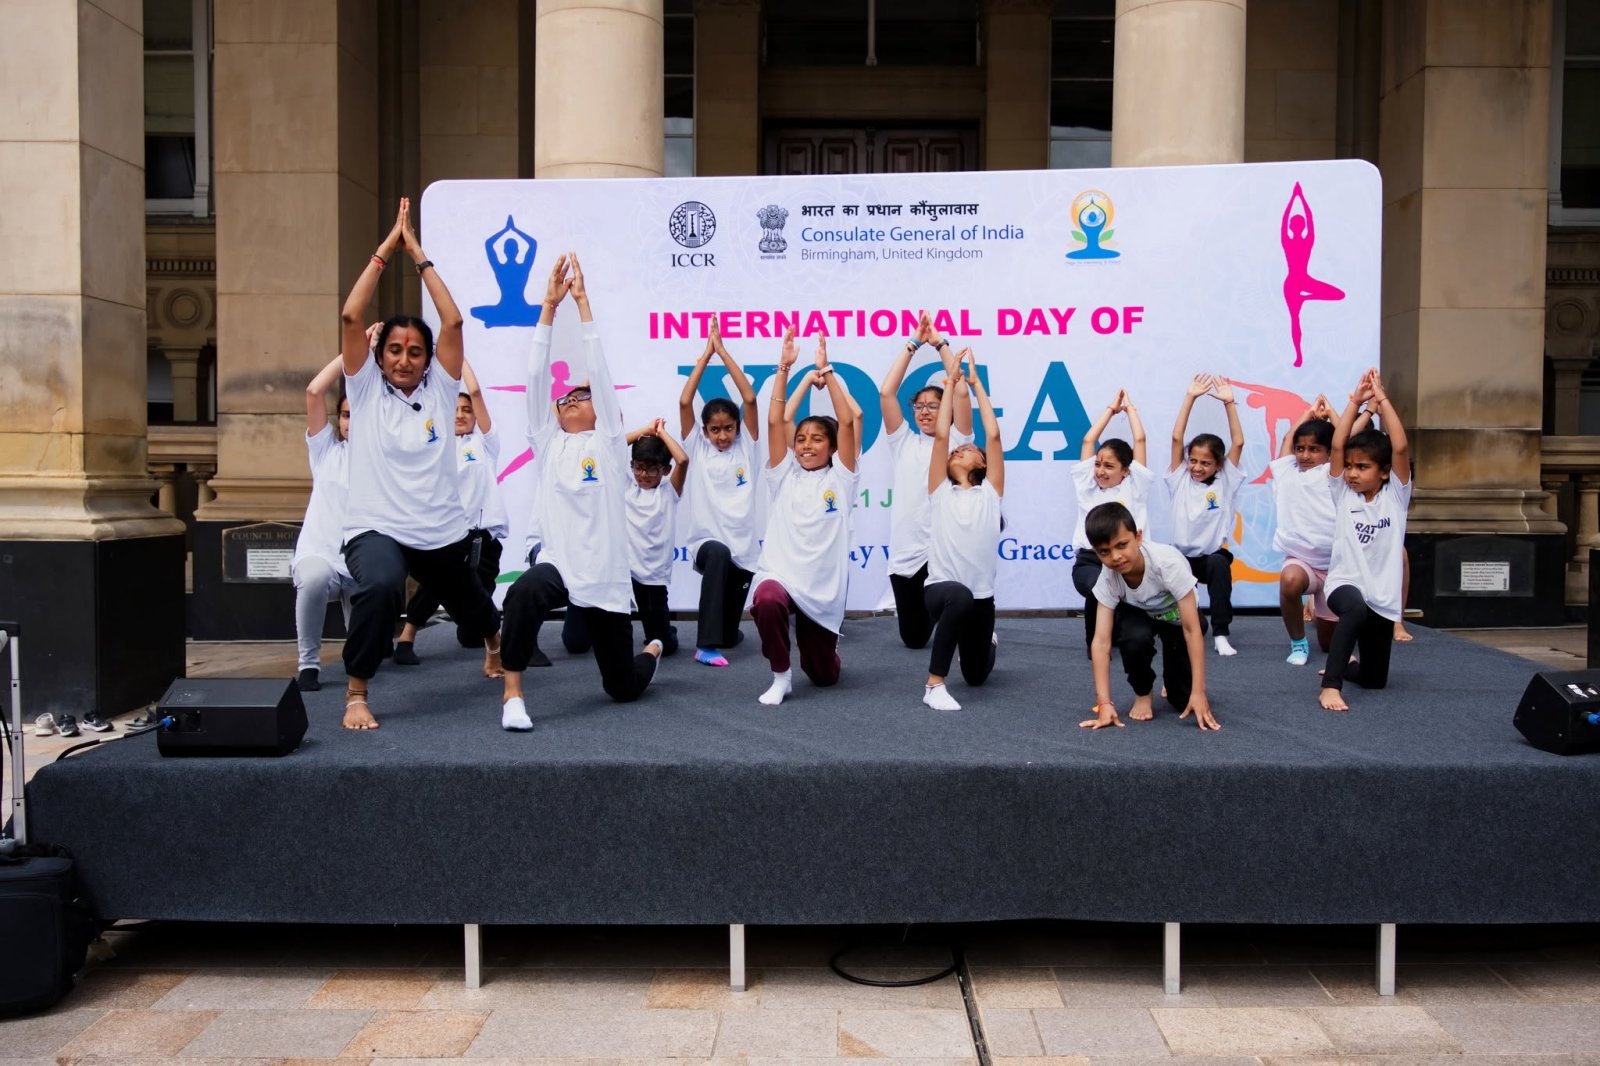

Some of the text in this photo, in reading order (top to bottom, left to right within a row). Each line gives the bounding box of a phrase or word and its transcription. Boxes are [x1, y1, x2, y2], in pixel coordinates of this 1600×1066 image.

[801, 204, 836, 217] भारत
[842, 204, 859, 217] का
[866, 204, 903, 217] प्रधान
[801, 224, 1025, 242] Consulate General of India
[671, 253, 717, 268] ICCR
[801, 246, 984, 263] Birmingham, United Kingdom
[649, 306, 1145, 339] INTERNATIONAL DAY OF
[997, 537, 1075, 561] Grace
